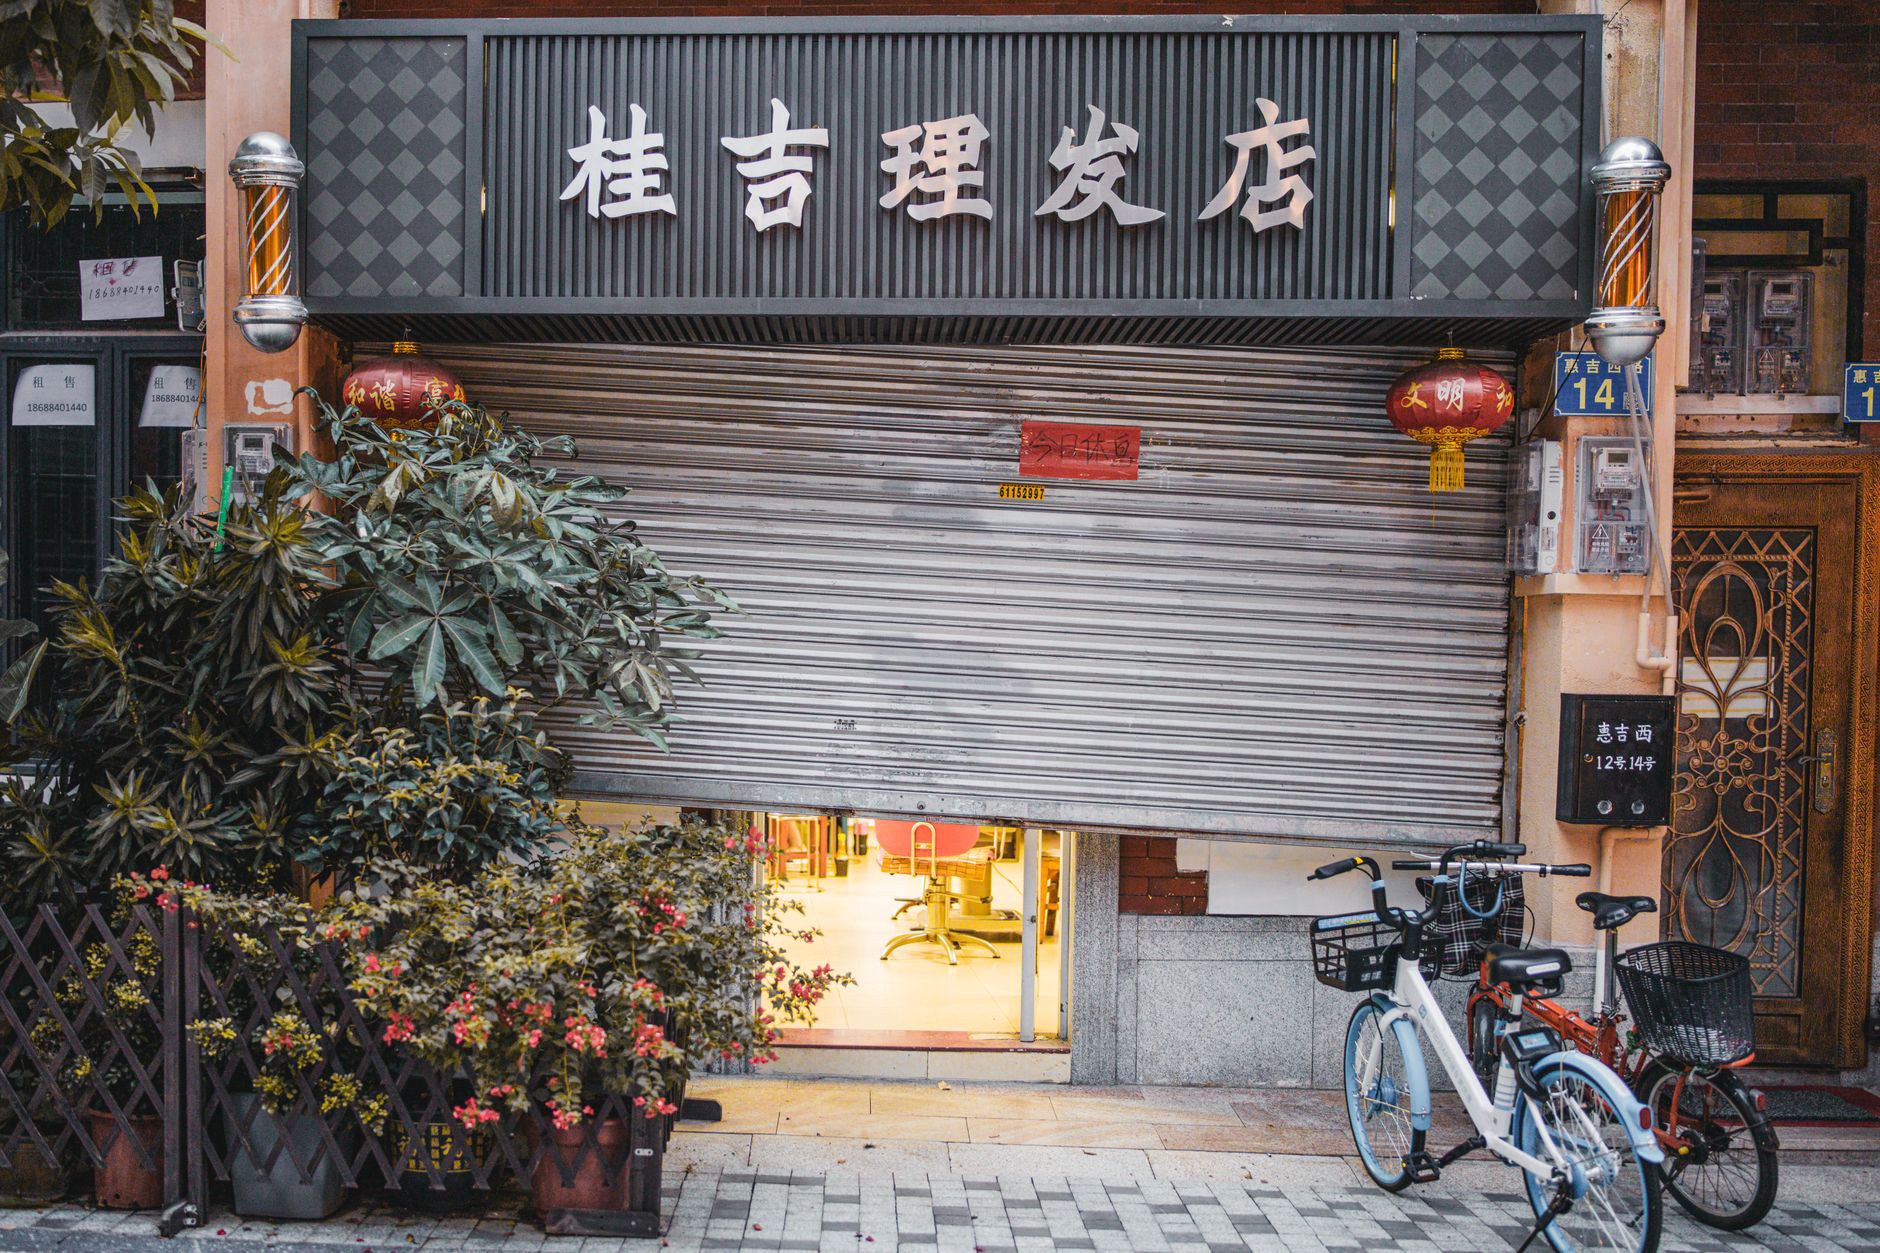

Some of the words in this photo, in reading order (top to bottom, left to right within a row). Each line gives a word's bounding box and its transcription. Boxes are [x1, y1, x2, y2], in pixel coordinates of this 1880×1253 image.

[558, 97, 1317, 233] 桂吉理发店
[88, 285, 160, 300] 18688401440
[32, 375, 76, 389] 租售
[348, 379, 397, 412] 和谐
[1400, 376, 1466, 412] 文明
[1573, 377, 1615, 410] 14
[27, 402, 88, 413] 18688401440
[1861, 386, 1875, 417] 1
[1029, 429, 1135, 468] 今日休息
[999, 485, 1045, 500] 61152997
[1595, 721, 1653, 744] 惠吉西
